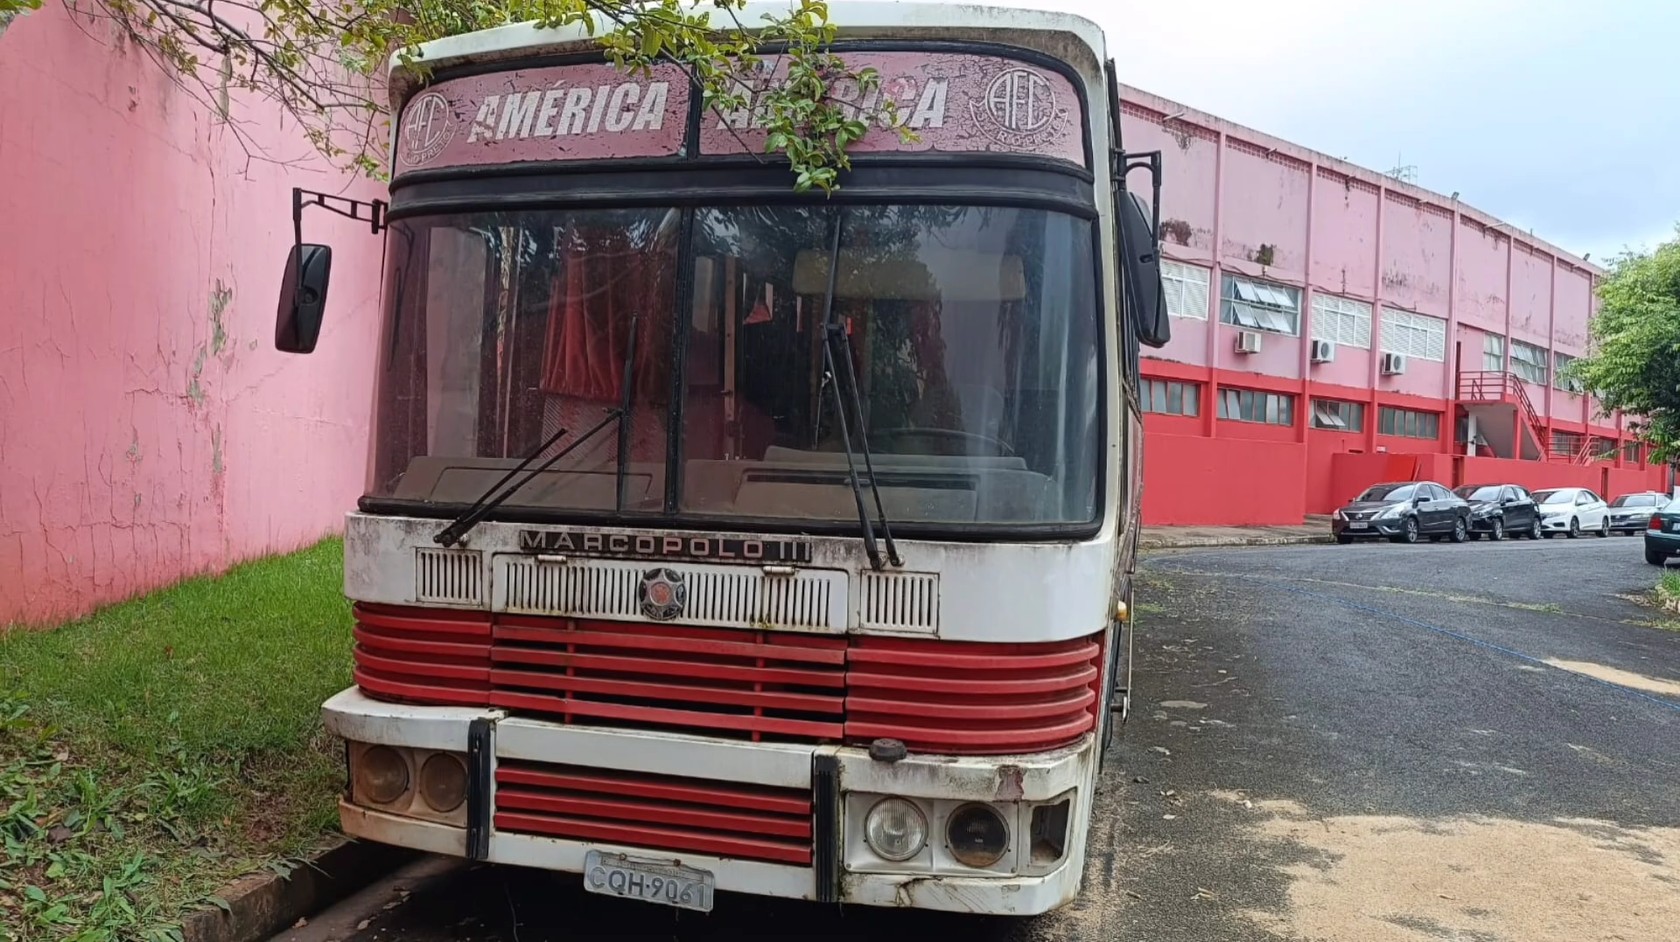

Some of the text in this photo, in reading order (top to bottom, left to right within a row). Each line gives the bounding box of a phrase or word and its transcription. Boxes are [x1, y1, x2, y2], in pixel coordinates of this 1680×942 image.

[467, 80, 670, 143] AMÉRICA
[716, 77, 949, 129] AMRICA
[520, 531, 764, 559] MARCOPOLO
